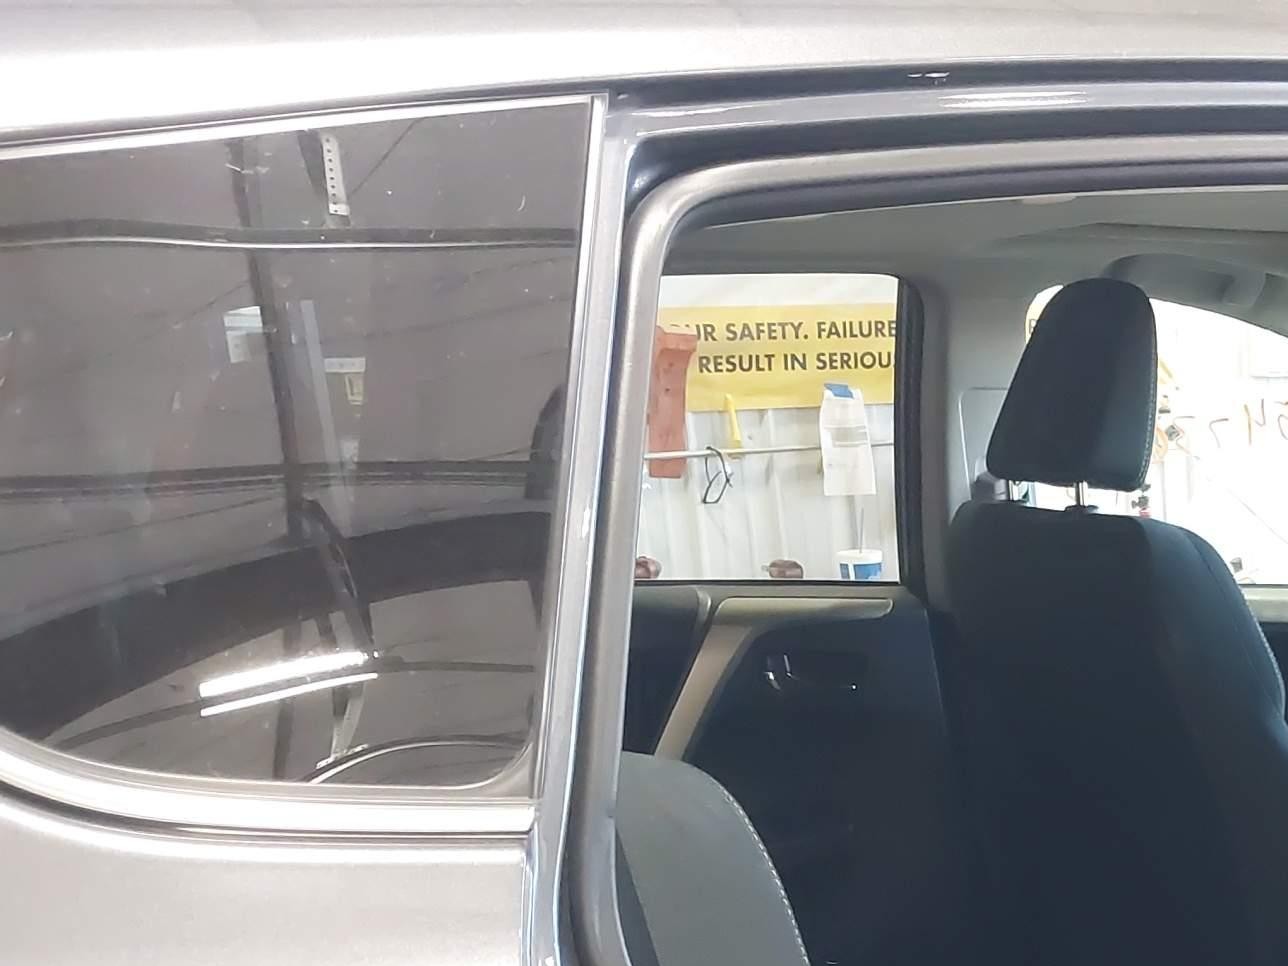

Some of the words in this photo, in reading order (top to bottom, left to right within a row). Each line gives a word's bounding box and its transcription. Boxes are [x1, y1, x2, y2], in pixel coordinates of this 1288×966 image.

[725, 322, 808, 341] SAFETY.
[816, 321, 896, 340] FAILURE
[697, 353, 776, 373] RESULT
[783, 353, 808, 371] IN
[816, 351, 895, 370] SERIOU
